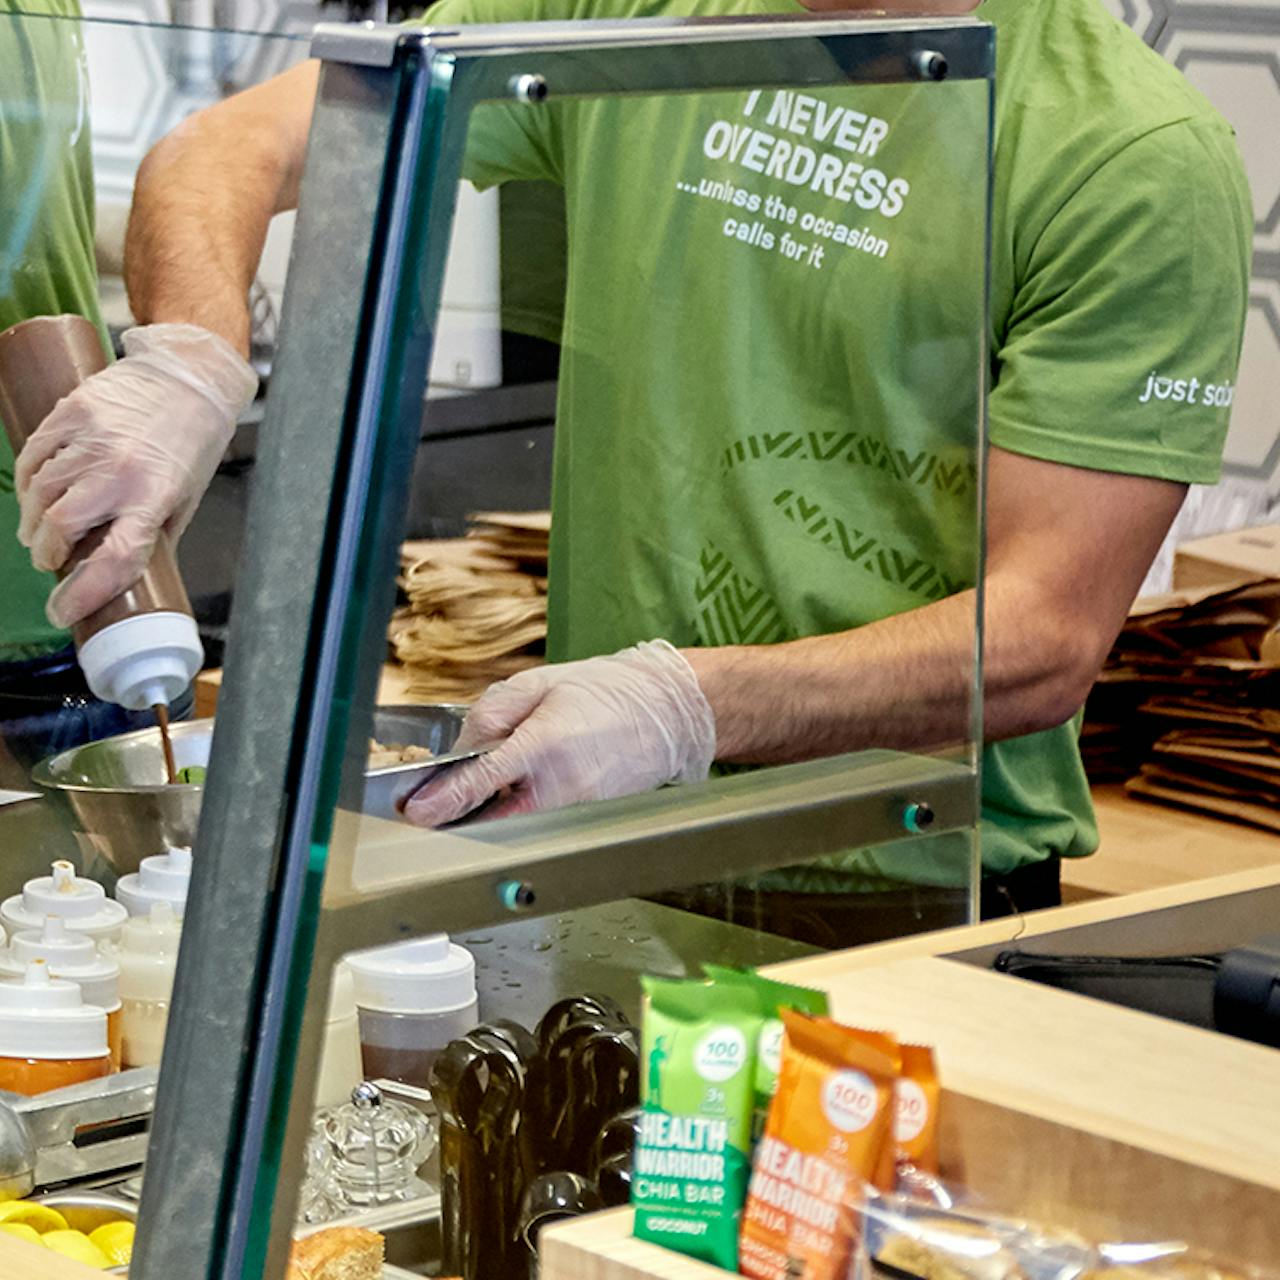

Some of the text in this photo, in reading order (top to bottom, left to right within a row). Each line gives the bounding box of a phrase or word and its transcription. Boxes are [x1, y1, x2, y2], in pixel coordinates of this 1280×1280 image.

[765, 88, 890, 158] NEVER
[702, 120, 910, 219] OVERDRESS
[722, 218, 825, 270] calls for it
[764, 194, 799, 225] the
[800, 212, 890, 259] occasion
[706, 1040, 740, 1058] 100
[831, 1082, 871, 1111] 100
[636, 1112, 728, 1153] HEALTH
[634, 1147, 725, 1183] WARRIOR
[757, 1136, 846, 1204] HEALTH
[631, 1178, 725, 1206] CHIA BAR
[748, 1169, 839, 1235] WARRIOR
[645, 1215, 709, 1236] COCONUT
